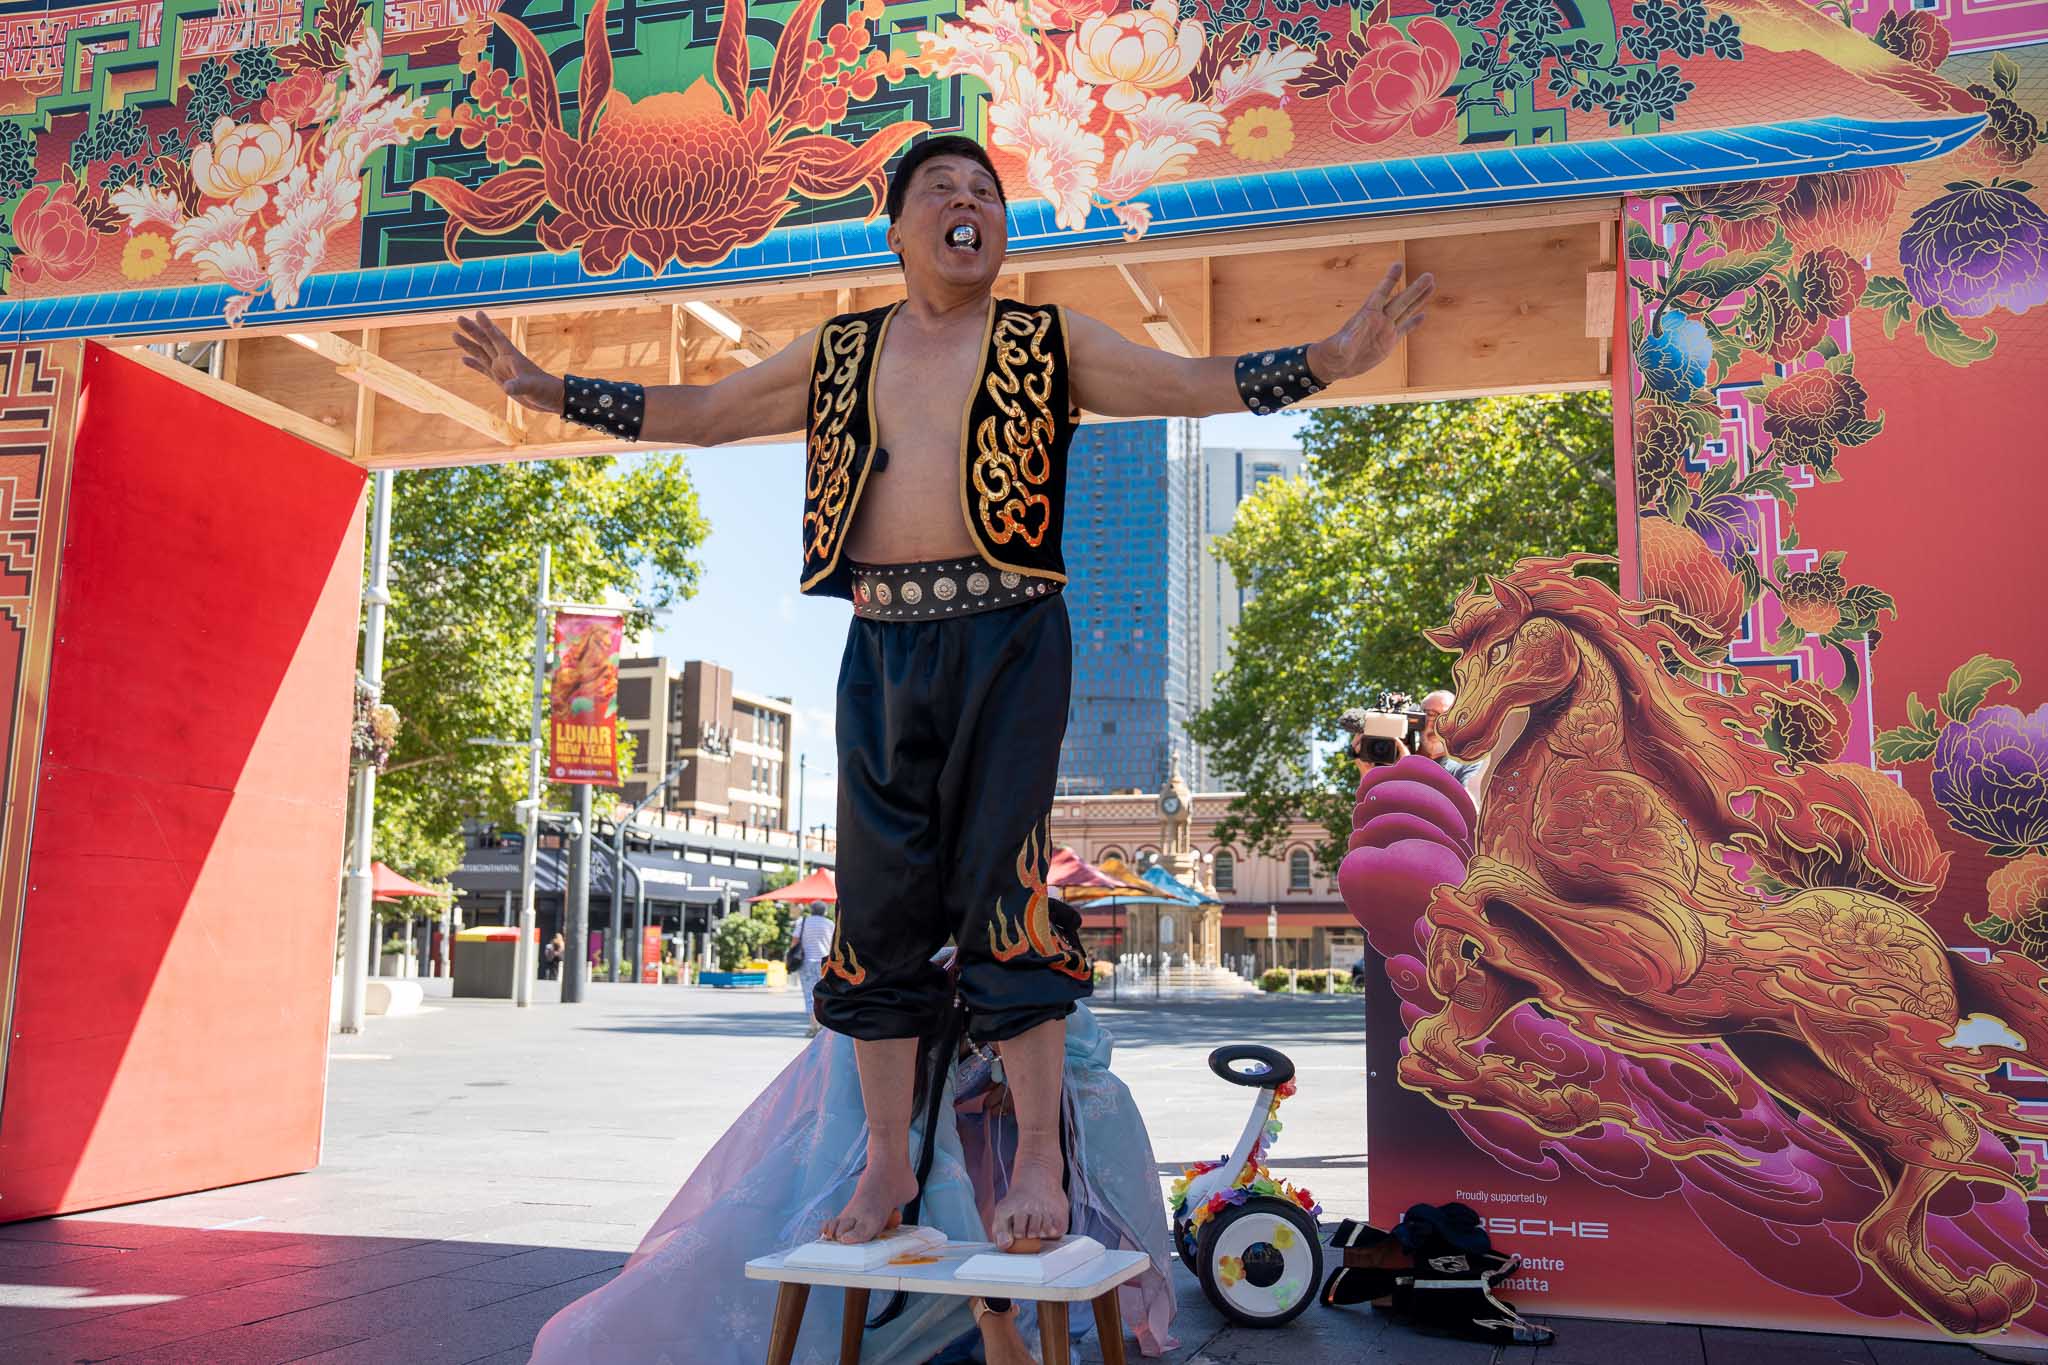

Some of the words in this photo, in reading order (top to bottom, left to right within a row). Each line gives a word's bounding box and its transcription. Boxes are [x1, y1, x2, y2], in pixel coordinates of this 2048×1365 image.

[556, 723, 611, 745] LUNAR
[556, 743, 581, 755] NEW
[583, 744, 611, 757] YEAR
[1456, 1189, 1489, 1203] Proudly
[1490, 1192, 1535, 1204] supported
[1536, 1193, 1548, 1206] by
